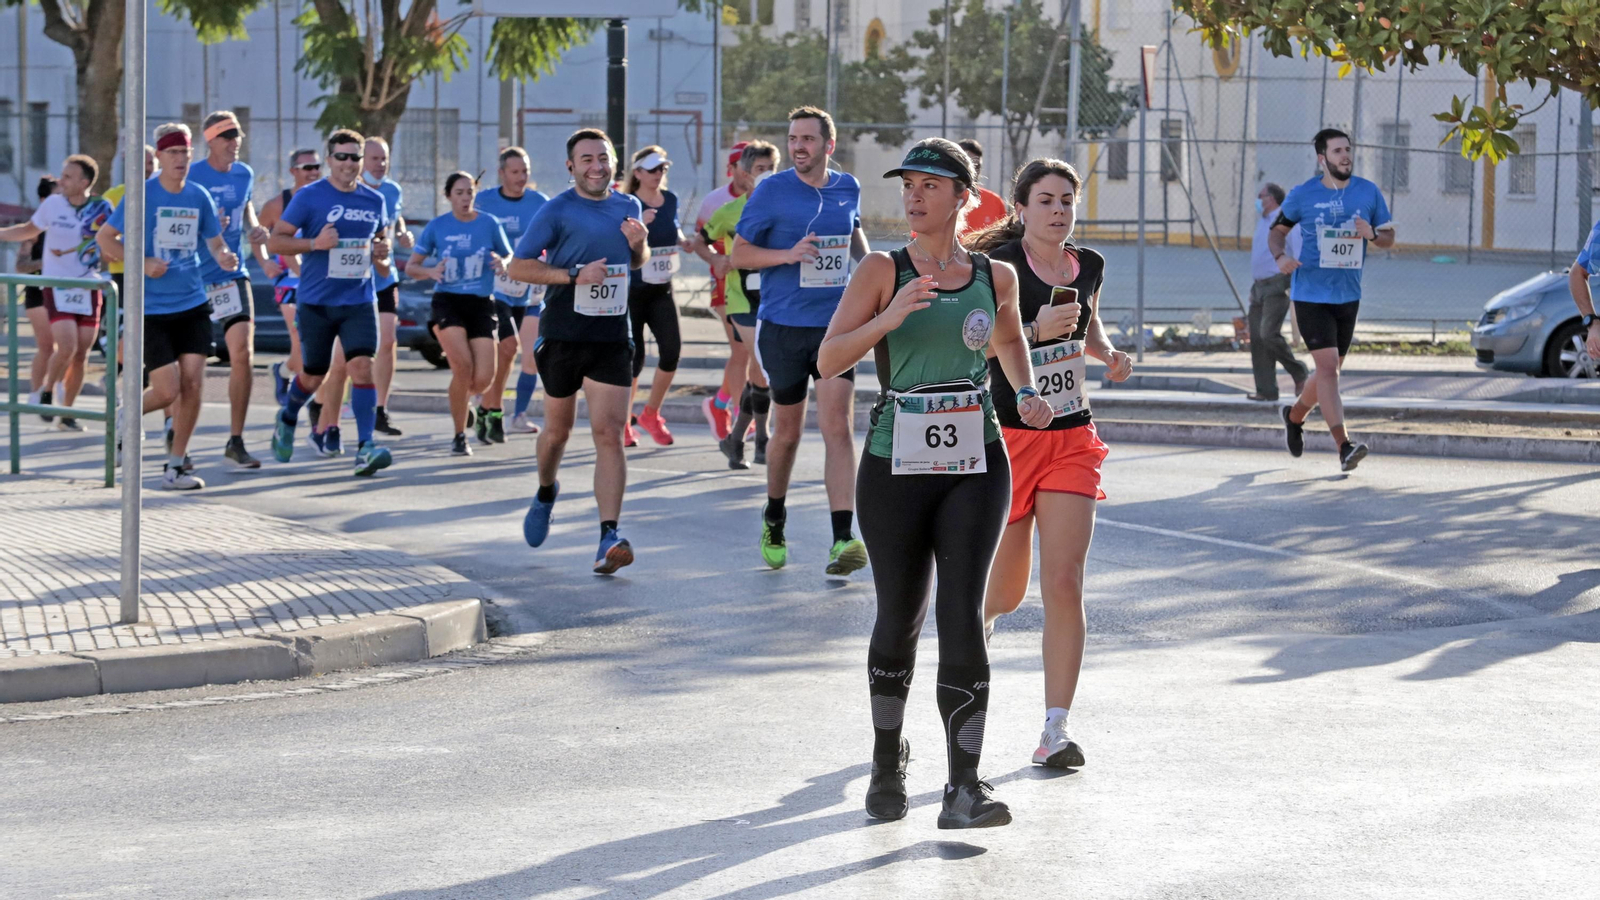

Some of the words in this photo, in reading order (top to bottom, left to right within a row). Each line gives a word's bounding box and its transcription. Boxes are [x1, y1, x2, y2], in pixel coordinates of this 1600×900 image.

[343, 208, 376, 222] asics
[168, 222, 191, 236] 467
[1331, 244, 1354, 256] 407
[341, 254, 363, 266] 592
[652, 260, 672, 272] 180
[815, 255, 842, 270] 326
[590, 284, 618, 299] 507
[1038, 369, 1074, 396] 298
[925, 424, 958, 448] 63
